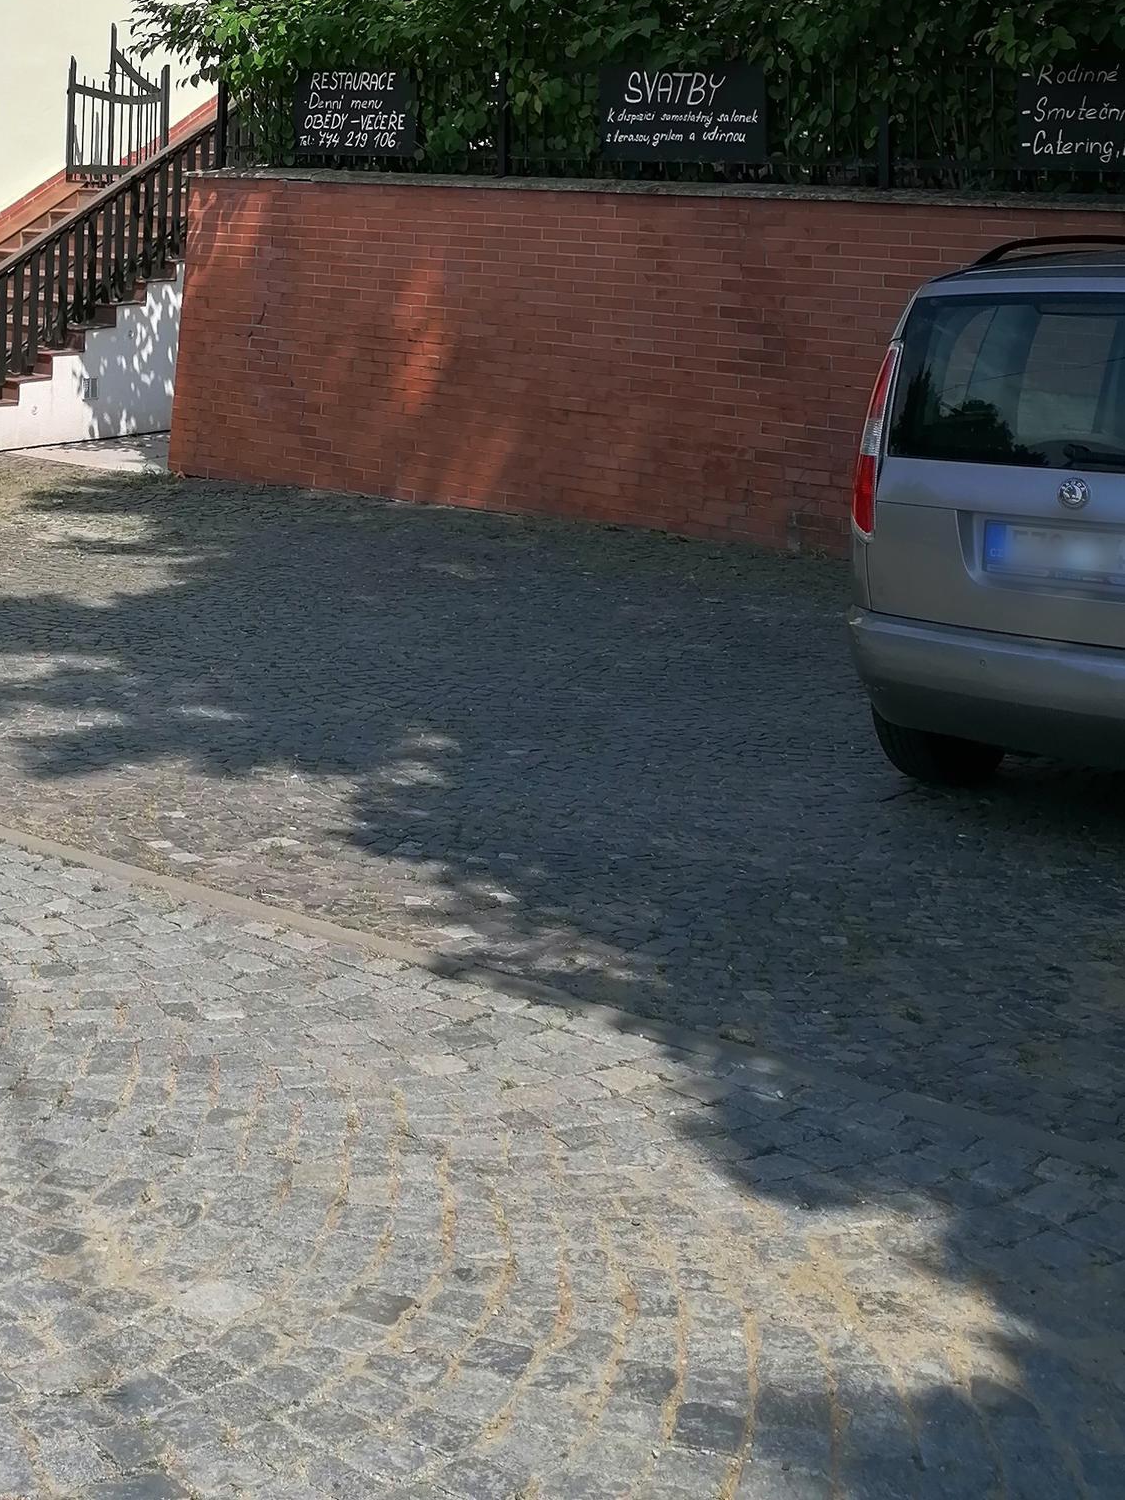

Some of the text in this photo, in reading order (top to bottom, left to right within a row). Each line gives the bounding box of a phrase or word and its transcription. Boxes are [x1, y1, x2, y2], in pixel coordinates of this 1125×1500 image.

[310, 71, 396, 91] RESTAURACE
[1037, 60, 1120, 86] Rodinné
[625, 70, 726, 106] SVATBY
[351, 99, 383, 110] menu
[717, 109, 758, 123] salonek
[344, 131, 368, 148] 219
[374, 132, 396, 148] 106
[689, 132, 696, 141] a
